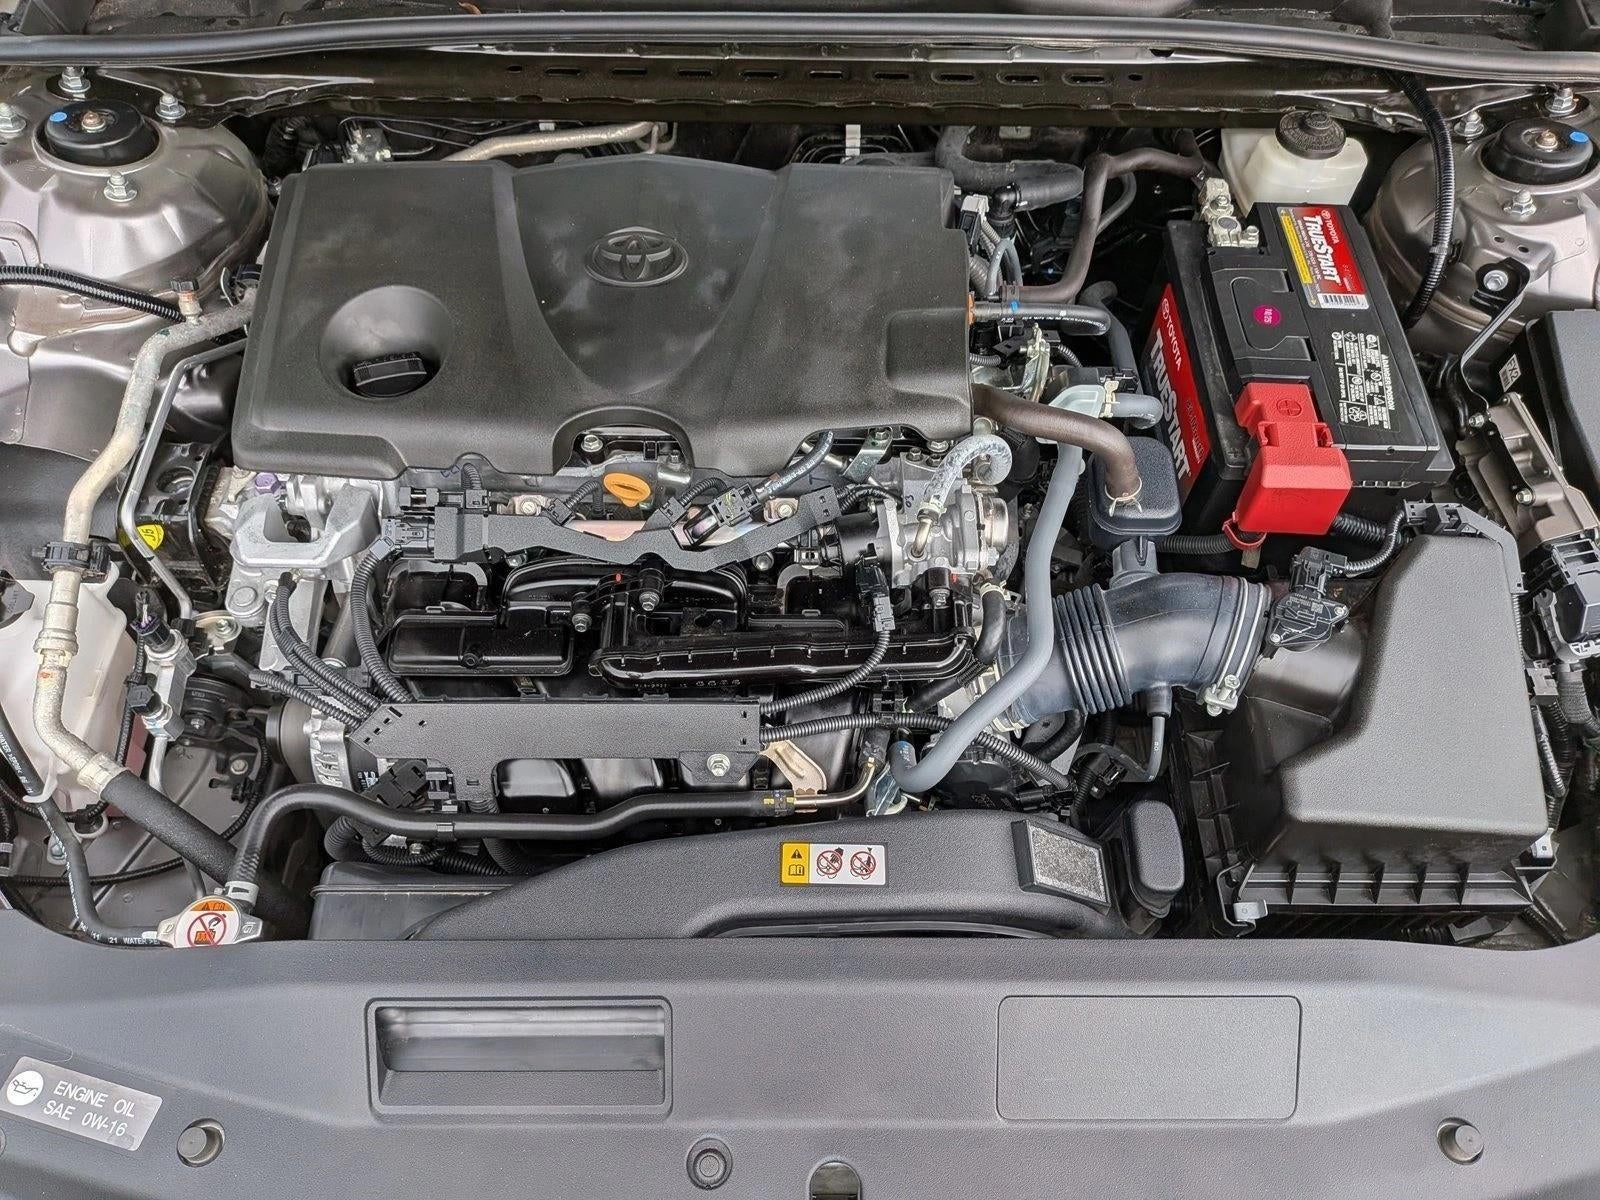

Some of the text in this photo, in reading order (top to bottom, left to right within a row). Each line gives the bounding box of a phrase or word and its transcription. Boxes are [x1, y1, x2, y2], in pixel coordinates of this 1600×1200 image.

[1326, 219, 1340, 244] TOYOTA
[1166, 319, 1182, 371] TOYOTA
[1507, 357, 1519, 382] FX2
[1150, 328, 1191, 480] TRUESTART
[54, 1081, 135, 1118] ENGINE OIL
[44, 1100, 128, 1137] SAE 0W-16
